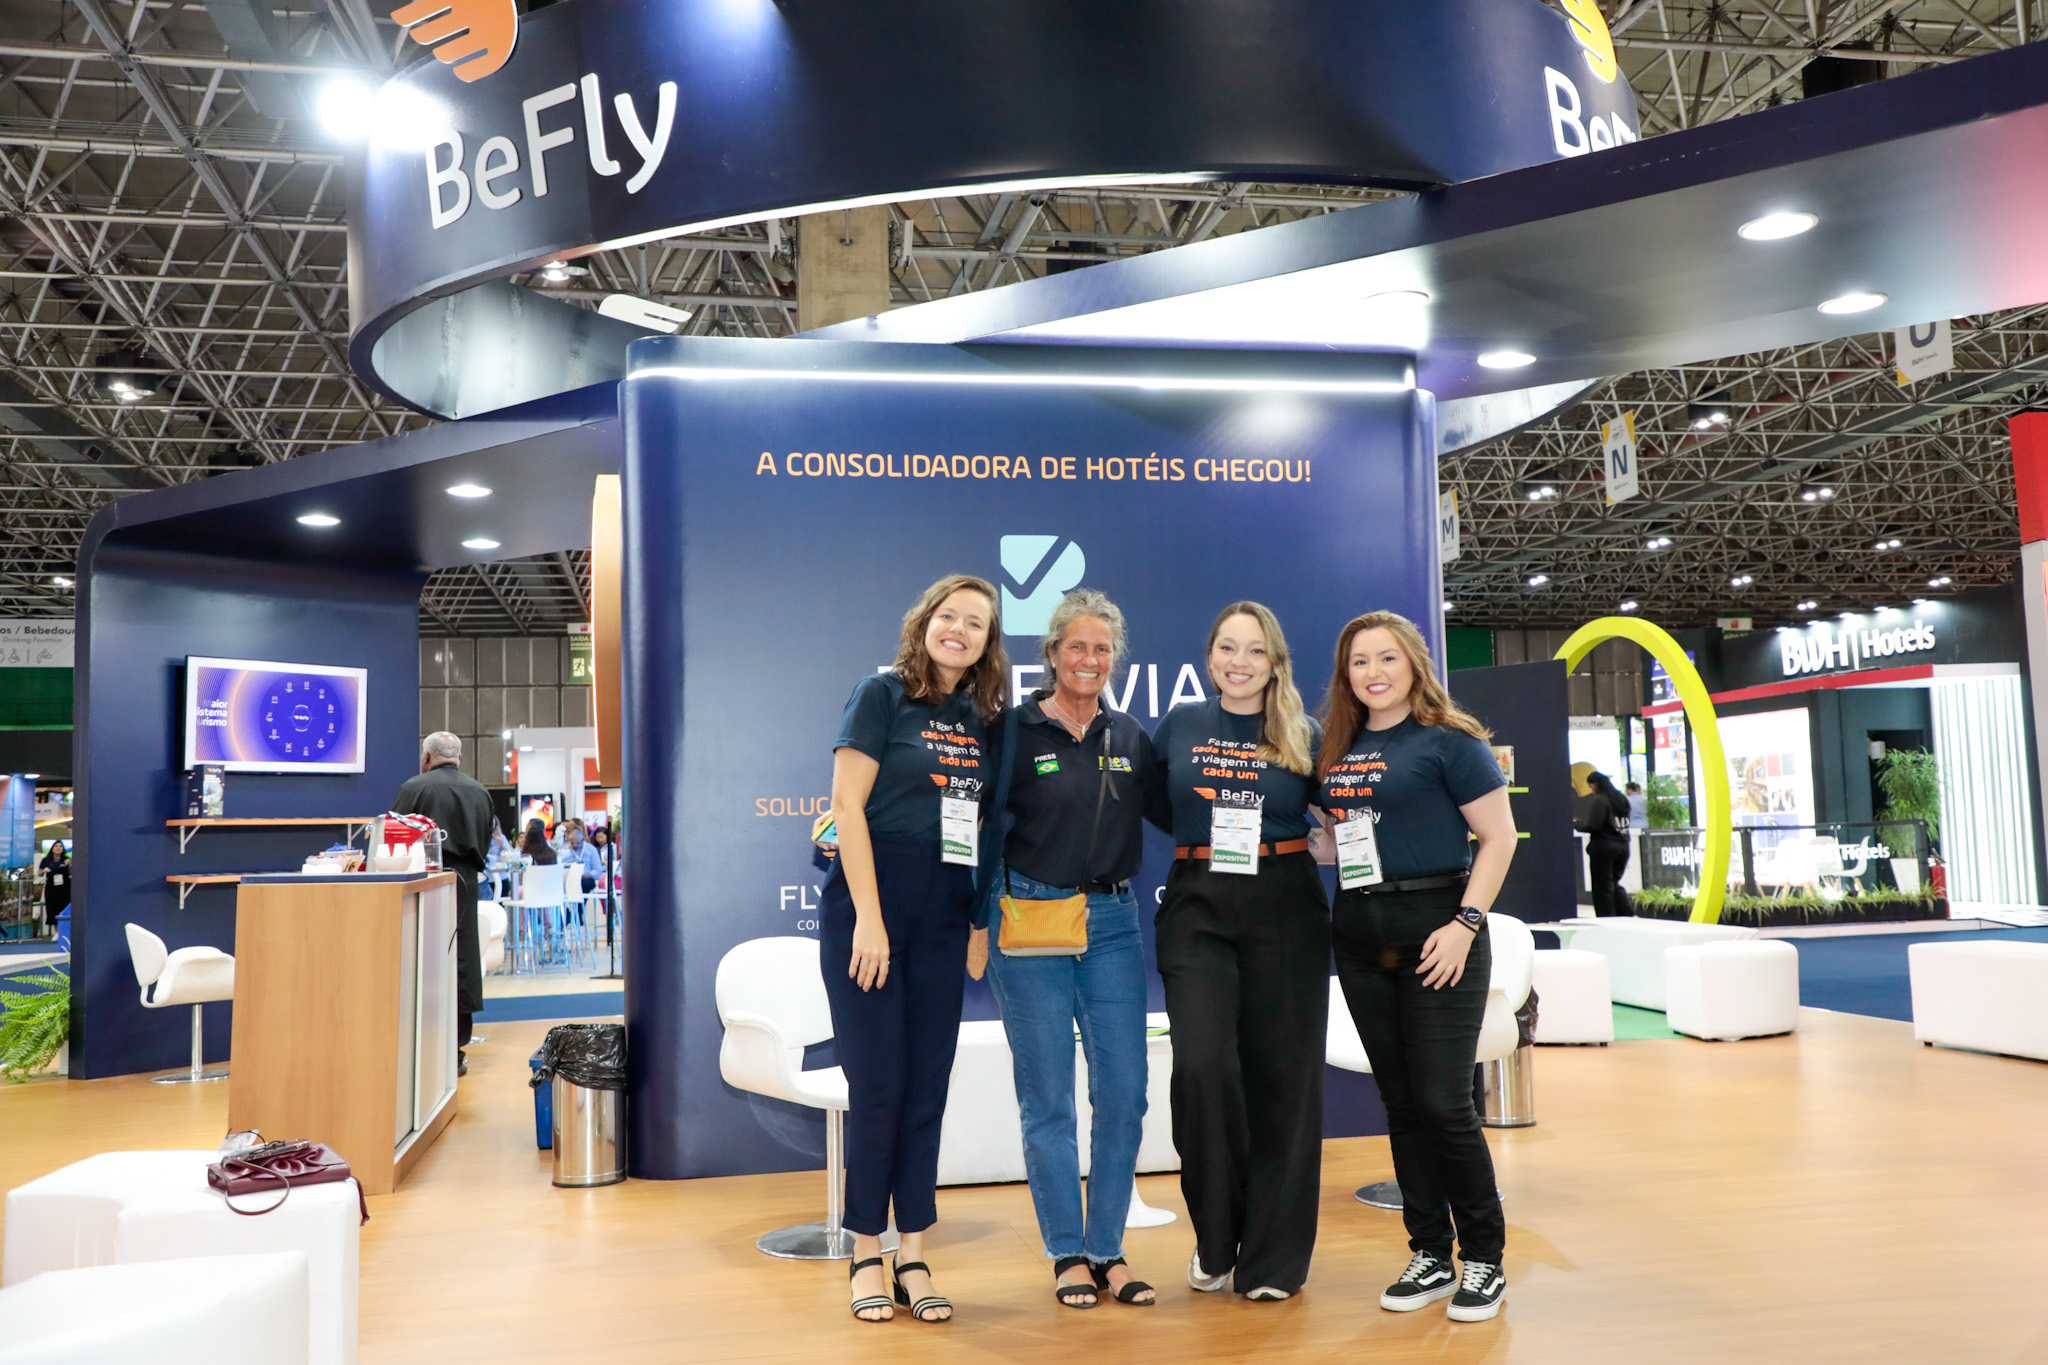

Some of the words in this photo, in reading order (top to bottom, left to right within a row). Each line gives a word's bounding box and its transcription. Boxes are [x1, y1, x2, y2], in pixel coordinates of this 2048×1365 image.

[1544, 66, 1637, 157] Be
[425, 73, 678, 230] BeFly
[756, 451, 777, 475] A
[786, 452, 1032, 479] CONSOLIDADORA
[1041, 456, 1077, 479] DE
[1086, 452, 1185, 481] HOTÉIS
[1193, 458, 1311, 482] CHEGOU!
[1612, 444, 1628, 479] N
[1443, 515, 1455, 543] M
[1780, 630, 1849, 676] BWH
[1861, 619, 1936, 658] Hotels
[929, 720, 954, 732] Fazer
[956, 722, 966, 733] de
[927, 742, 934, 750] a
[935, 742, 968, 756] viagem
[969, 746, 981, 756] de
[1208, 737, 1240, 749] Fazer
[1242, 742, 1257, 750] de
[1034, 753, 1057, 763] PRESS
[1192, 745, 1220, 754] cada
[1222, 748, 1257, 759] viage
[1191, 755, 1199, 764] a
[1202, 754, 1248, 768] viagem
[1252, 760, 1268, 769] de
[1202, 767, 1234, 778] cada
[1236, 770, 1259, 780] um
[1368, 771, 1382, 782] de
[950, 776, 983, 792] BeFly
[1221, 788, 1265, 803] BeFly
[1330, 786, 1356, 797] cada
[1357, 787, 1373, 797] um
[944, 844, 971, 854] EXPOSITOR
[1841, 843, 1891, 860] Hotels
[1214, 854, 1249, 863] EXPOSITOR
[1661, 846, 1690, 867] BWH
[1342, 867, 1372, 878] EXPOSITOR
